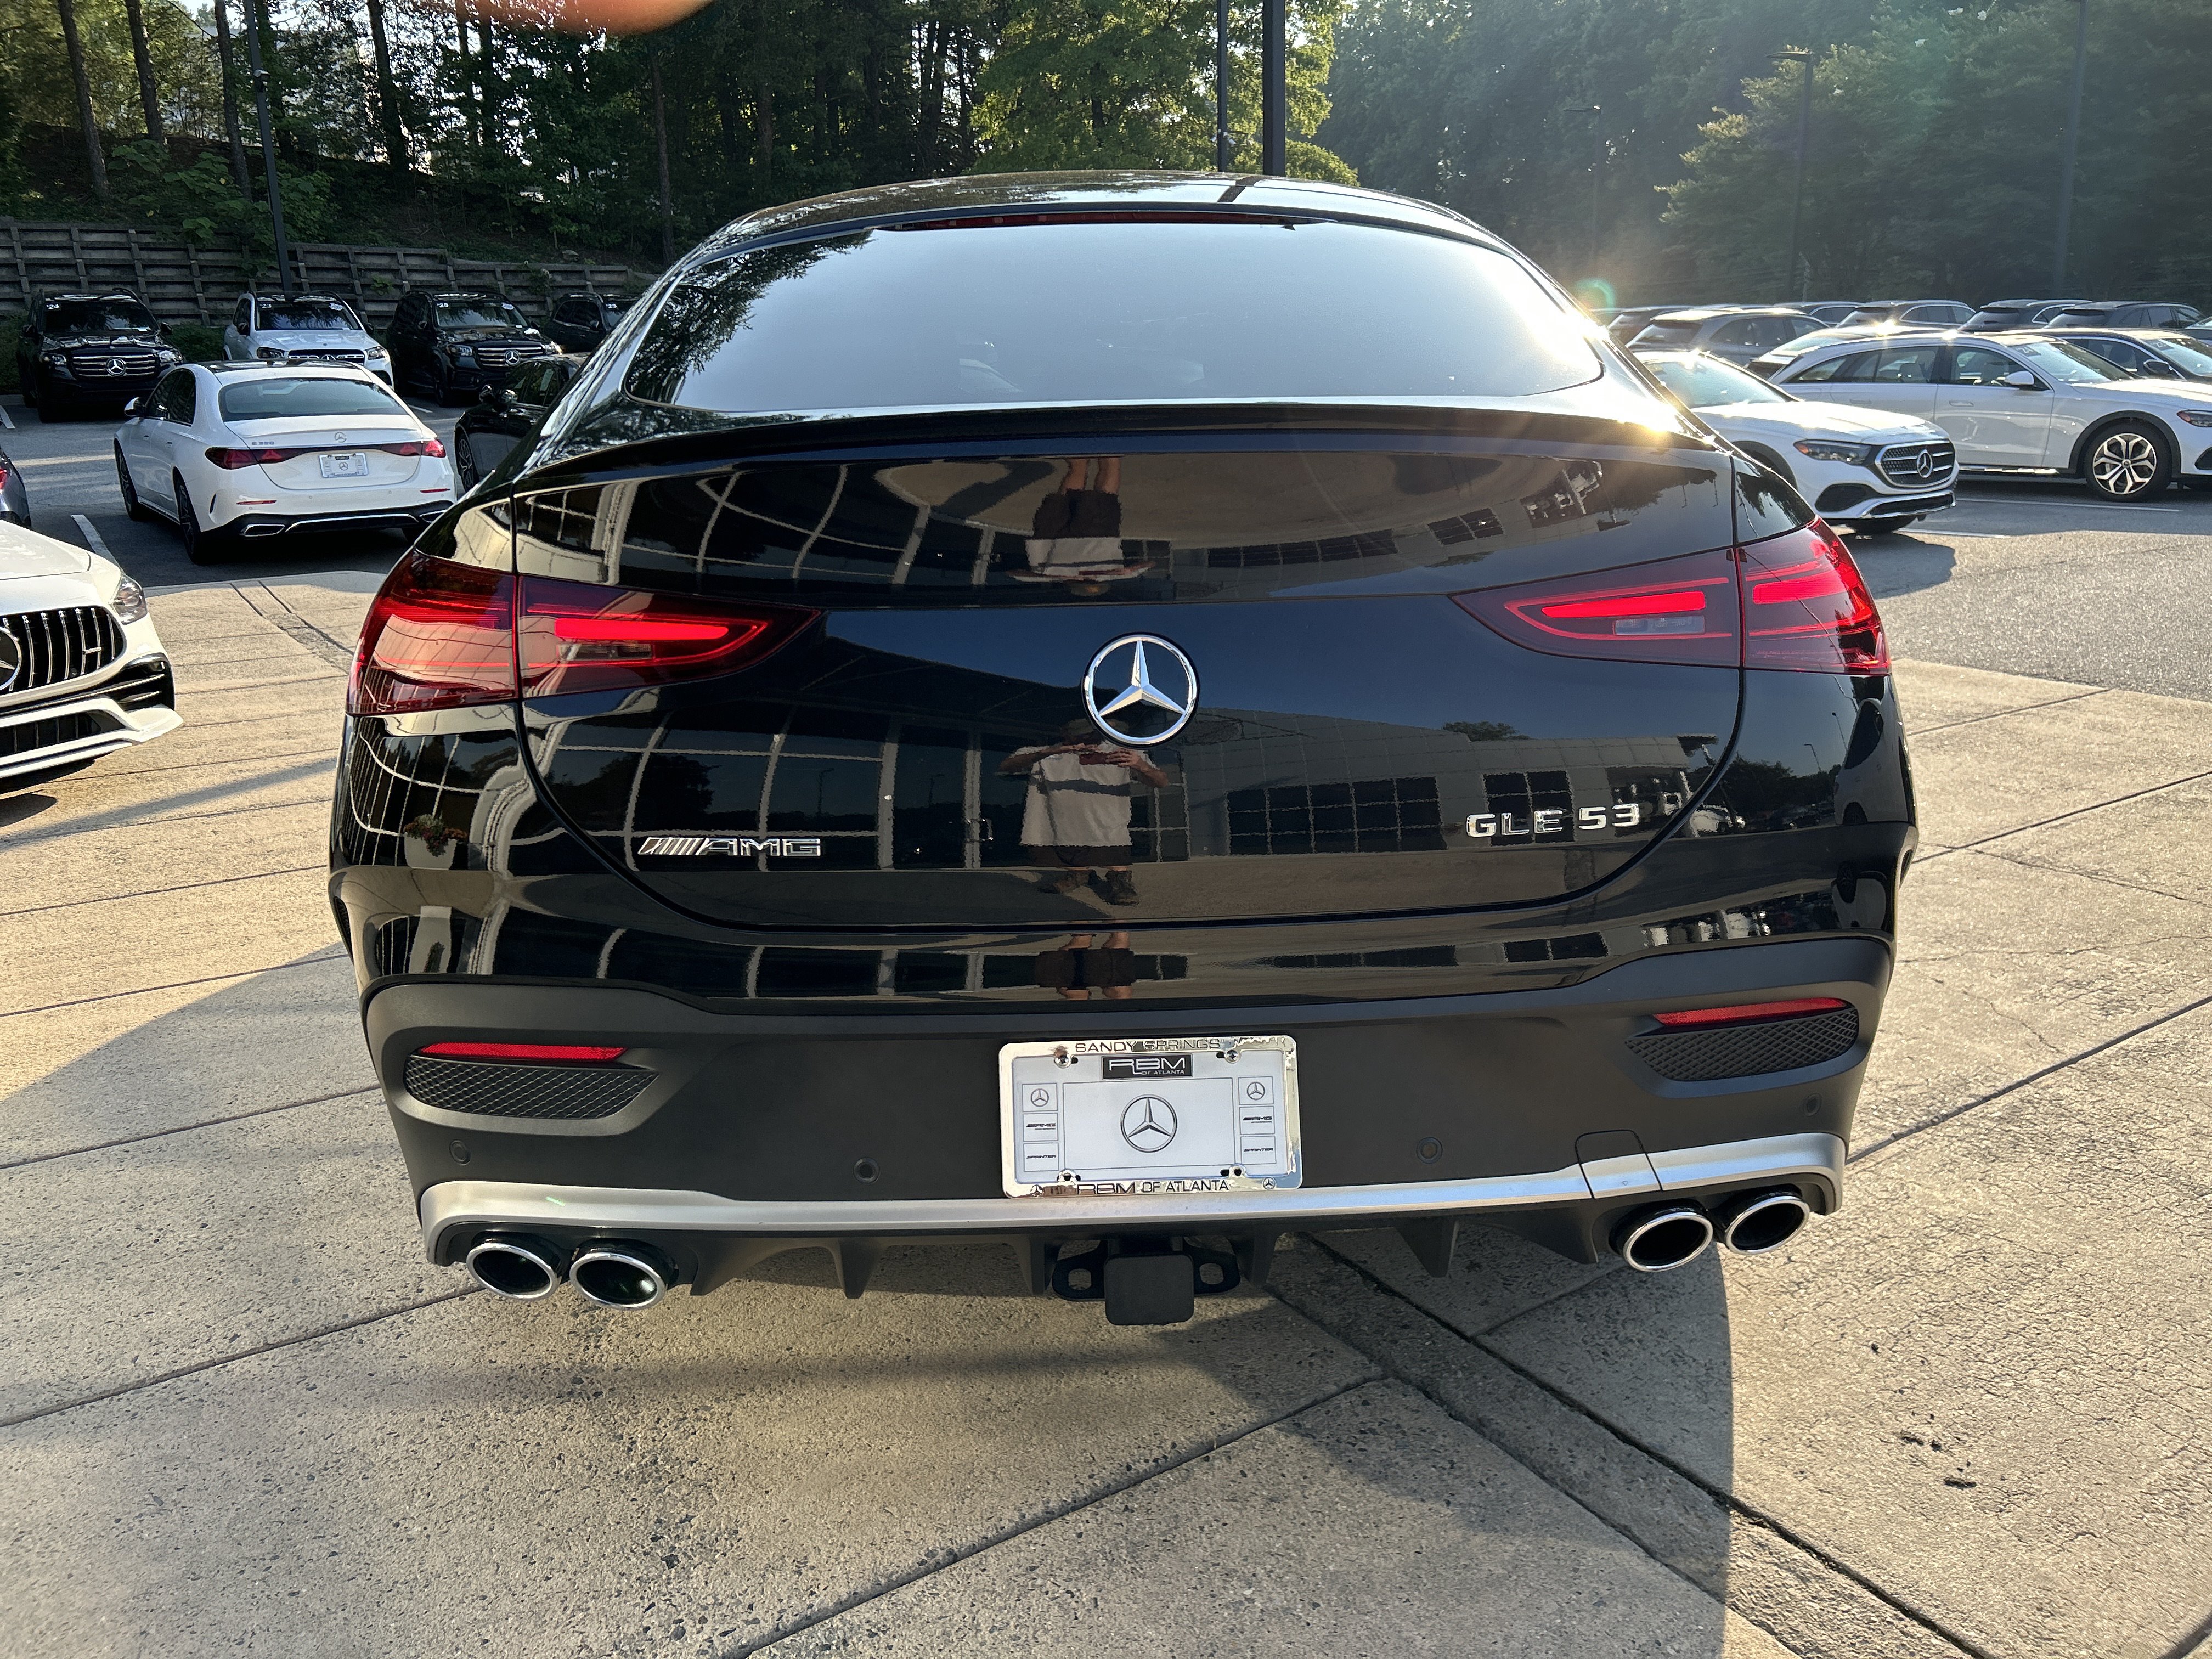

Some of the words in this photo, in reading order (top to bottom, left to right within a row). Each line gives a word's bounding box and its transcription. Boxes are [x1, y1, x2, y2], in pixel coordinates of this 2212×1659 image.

[1466, 810, 1563, 838] GLE
[1578, 803, 1640, 831] 53
[695, 837, 822, 856] AMG
[1075, 1041, 1137, 1053] SANDY
[1144, 1039, 1221, 1051] SPRINGS
[1109, 1057, 1186, 1075] RBM
[1077, 1183, 1136, 1194] RBM
[1142, 1181, 1161, 1193] OF
[1166, 1180, 1229, 1192] ATLANTA
